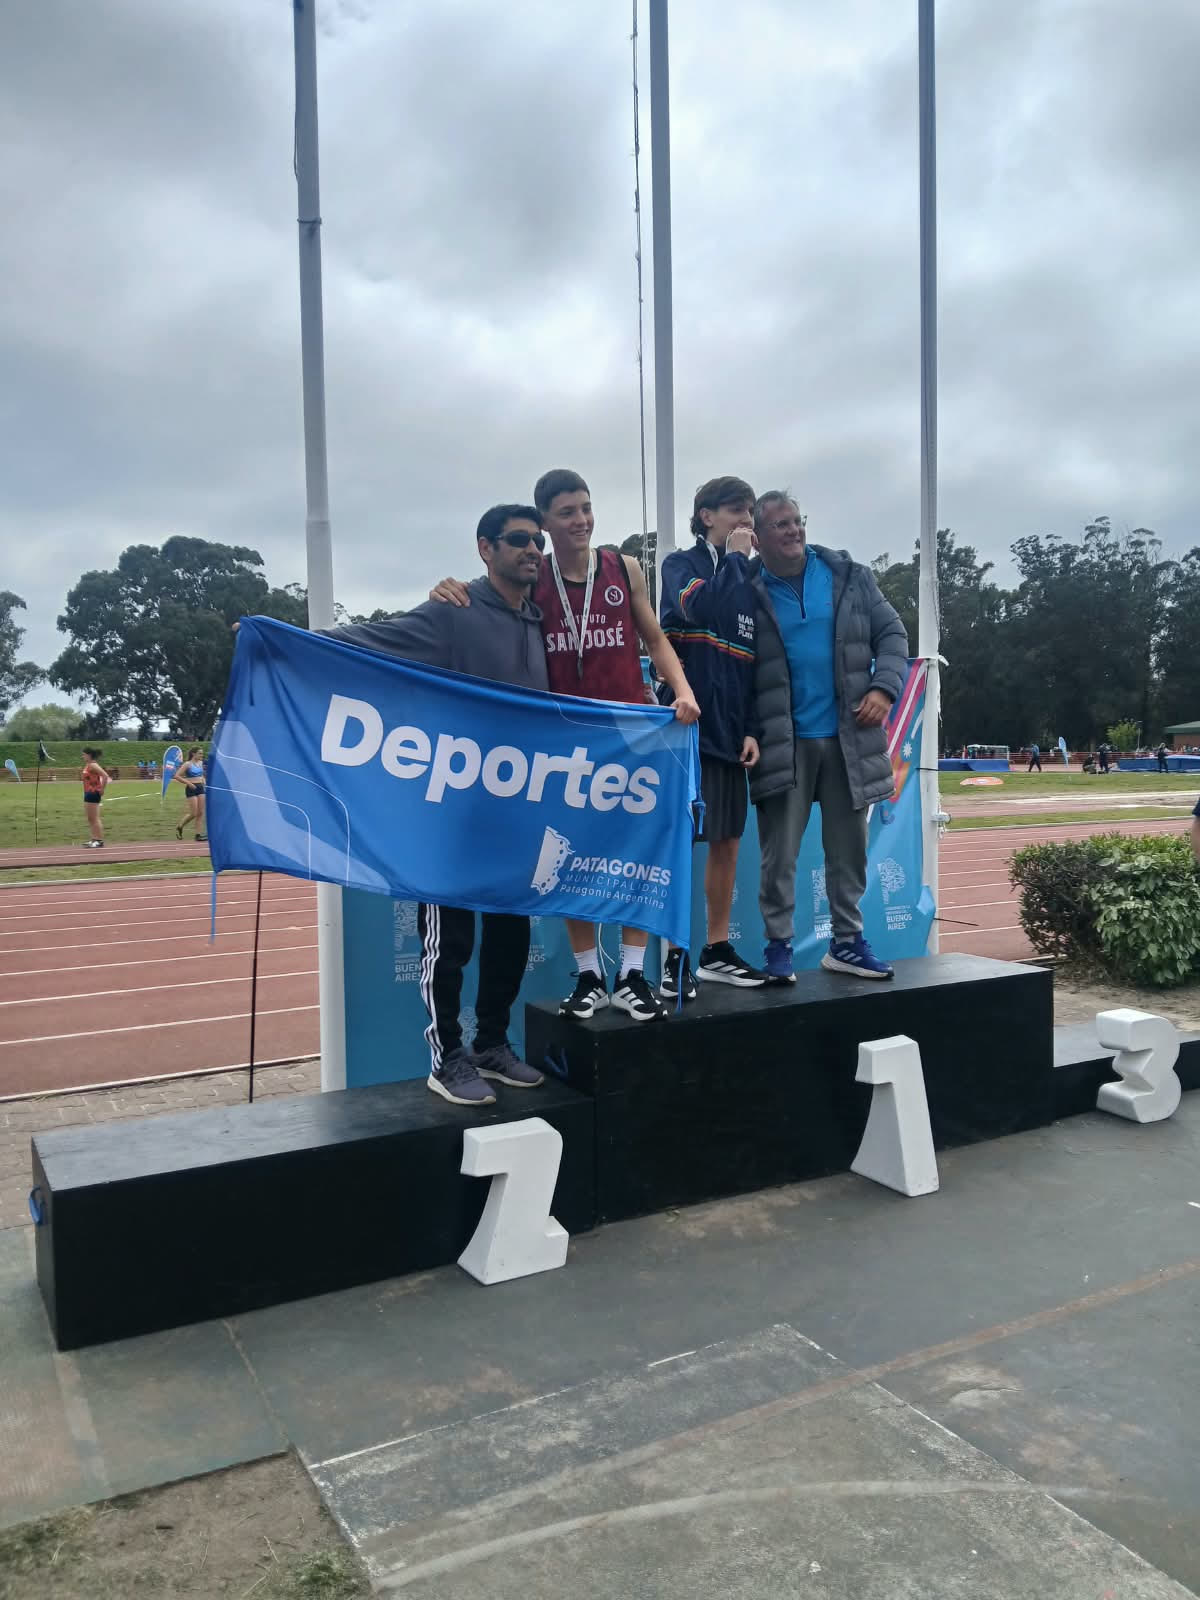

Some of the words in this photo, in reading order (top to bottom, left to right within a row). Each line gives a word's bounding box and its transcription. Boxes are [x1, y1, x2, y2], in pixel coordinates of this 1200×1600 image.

[546, 631, 580, 653] SAN
[585, 620, 625, 650] JOSÉ
[320, 693, 661, 815] Deportes
[565, 874, 668, 898] MUNICIPALIDAD
[570, 856, 672, 886] PATAGONES
[395, 963, 422, 973] BUEN
[1096, 1009, 1181, 1123] 3
[850, 1034, 940, 1197] 1
[457, 1117, 569, 1286] 2
